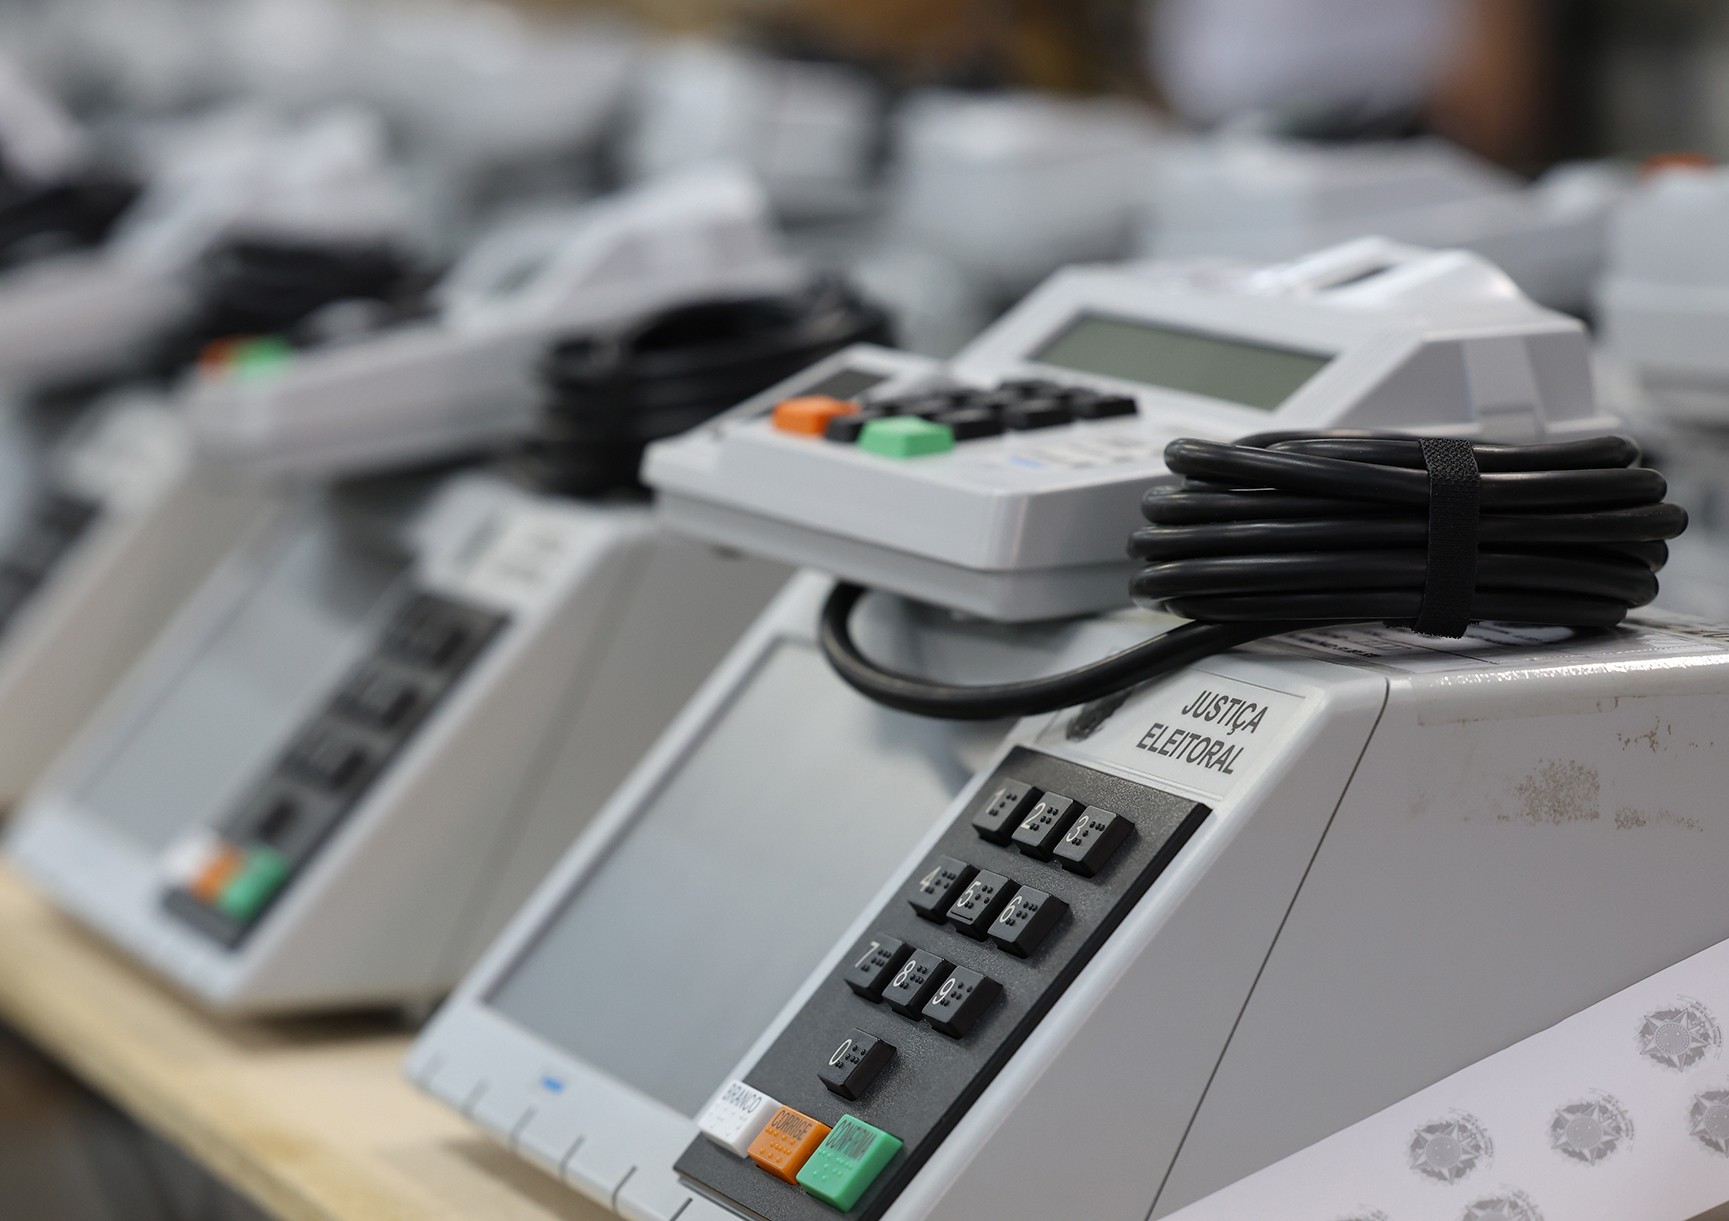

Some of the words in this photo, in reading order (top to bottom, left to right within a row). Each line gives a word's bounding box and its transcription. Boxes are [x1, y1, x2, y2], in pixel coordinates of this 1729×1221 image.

[1181, 689, 1269, 736] JUSTIÇA
[1136, 722, 1245, 775] ELEITORAL
[985, 788, 1007, 813] 1
[1019, 802, 1047, 830] 2
[1066, 815, 1089, 843] 3
[919, 865, 942, 892] 4
[956, 880, 982, 909] 5
[999, 895, 1023, 923] 6
[854, 941, 880, 968] 7
[892, 960, 916, 988] 8
[932, 977, 956, 1006] 9
[828, 1038, 852, 1066] 0
[722, 1083, 762, 1114] BRANCO
[771, 1109, 813, 1141] CORRIGE
